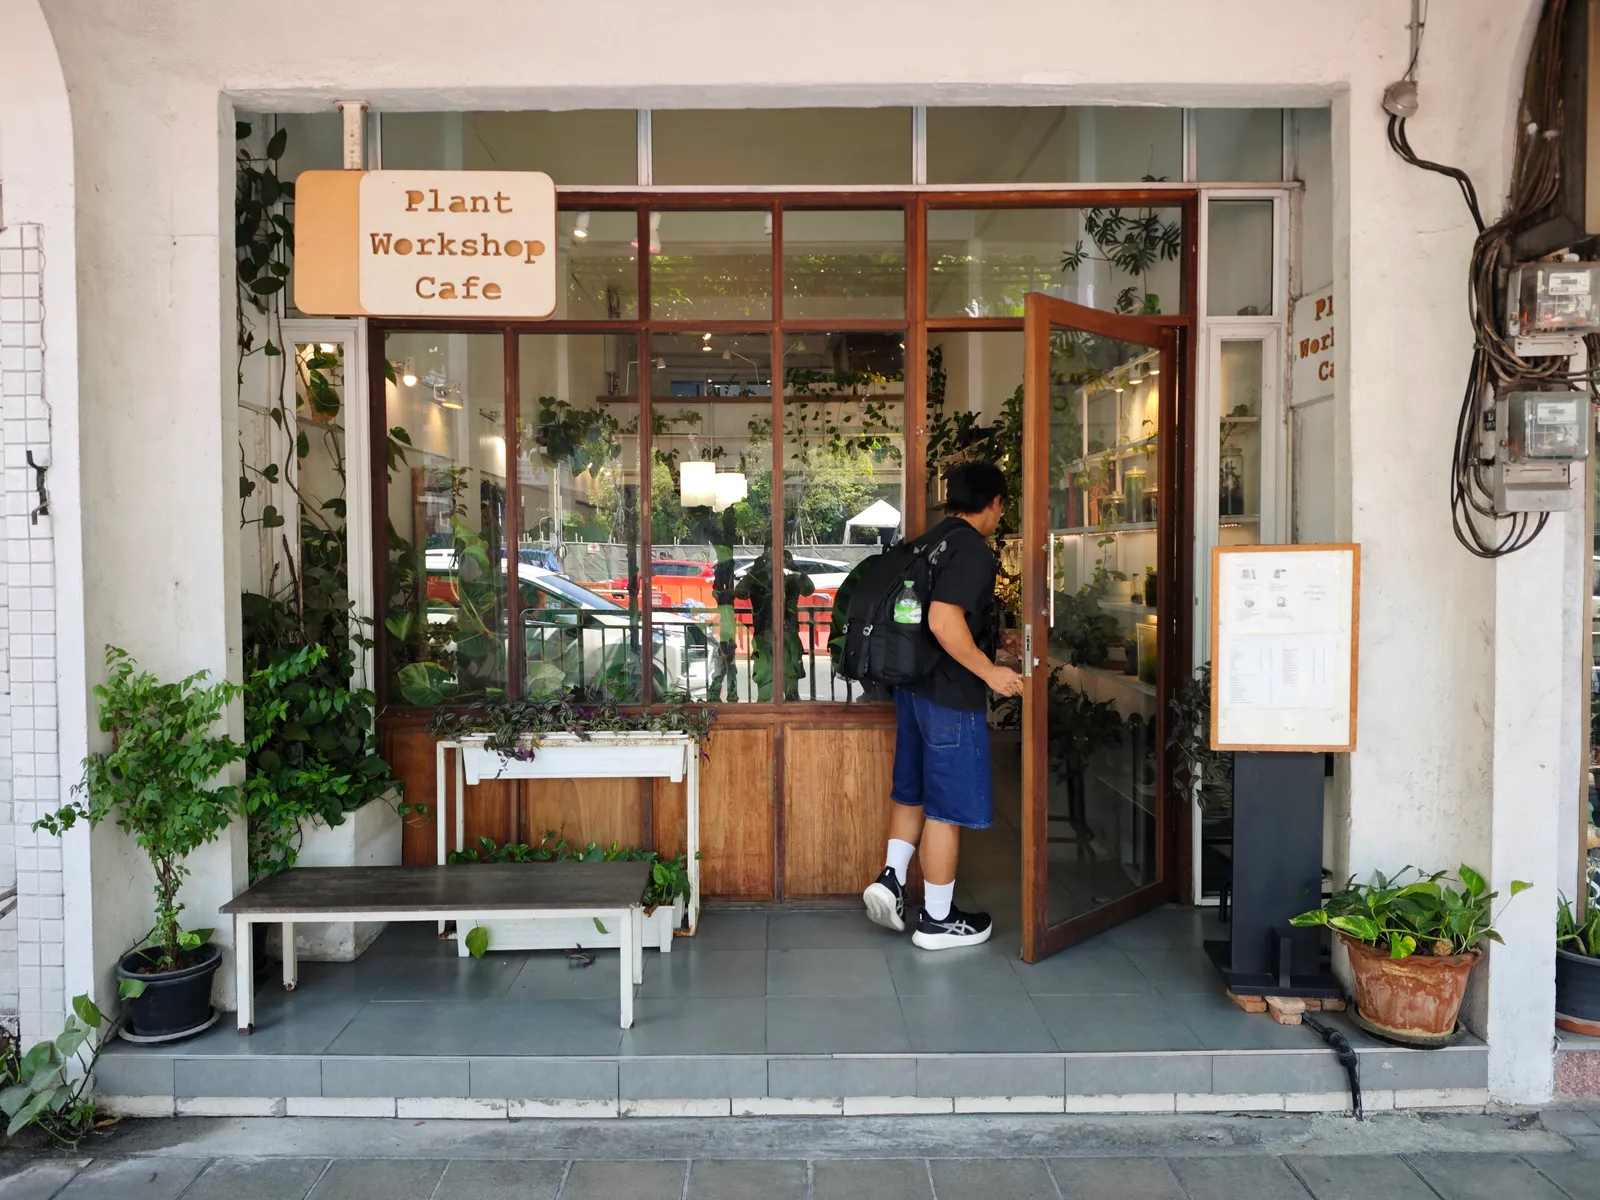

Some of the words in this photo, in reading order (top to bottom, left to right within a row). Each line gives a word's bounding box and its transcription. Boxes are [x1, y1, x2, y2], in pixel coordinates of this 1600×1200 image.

[405, 189, 513, 214] Plant
[369, 232, 546, 264] Workshop
[415, 276, 502, 300] Cafe
